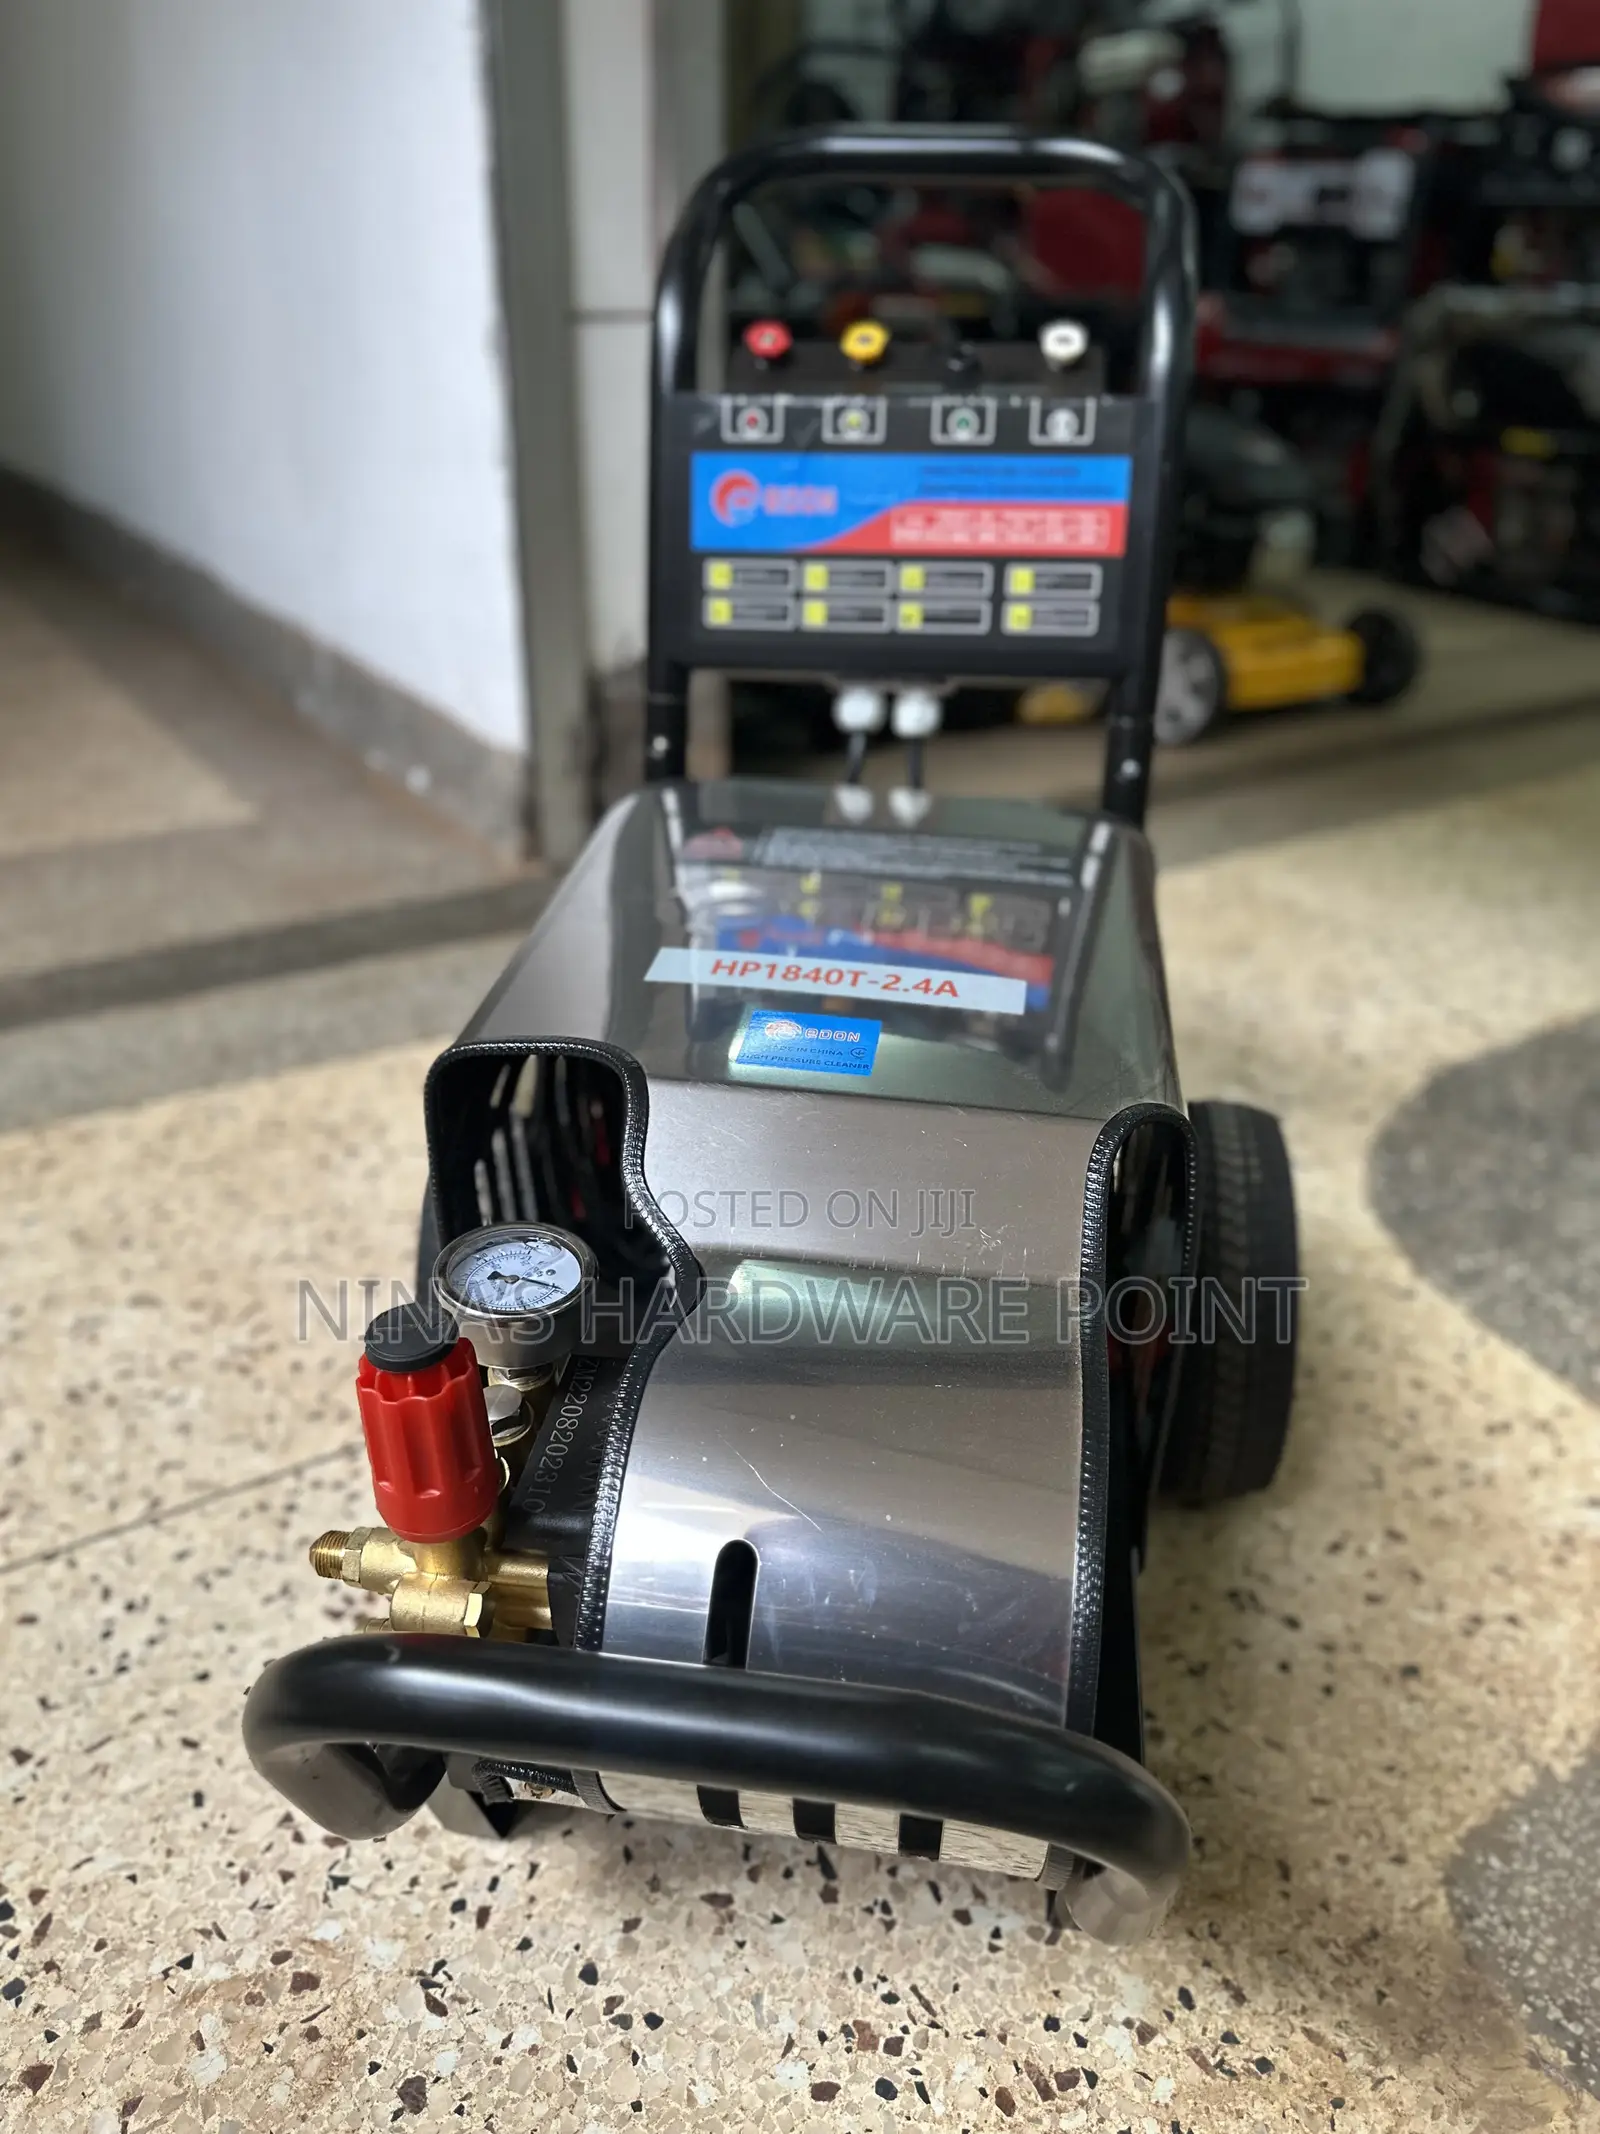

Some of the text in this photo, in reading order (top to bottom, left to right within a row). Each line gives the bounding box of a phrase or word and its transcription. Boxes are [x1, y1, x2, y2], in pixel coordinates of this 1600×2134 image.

[711, 958, 960, 998] HP1840T-2.4A
[809, 1048, 844, 1056] CHINA
[770, 1055, 821, 1066] PRESSURE
[823, 1059, 871, 1071] CLEANER
